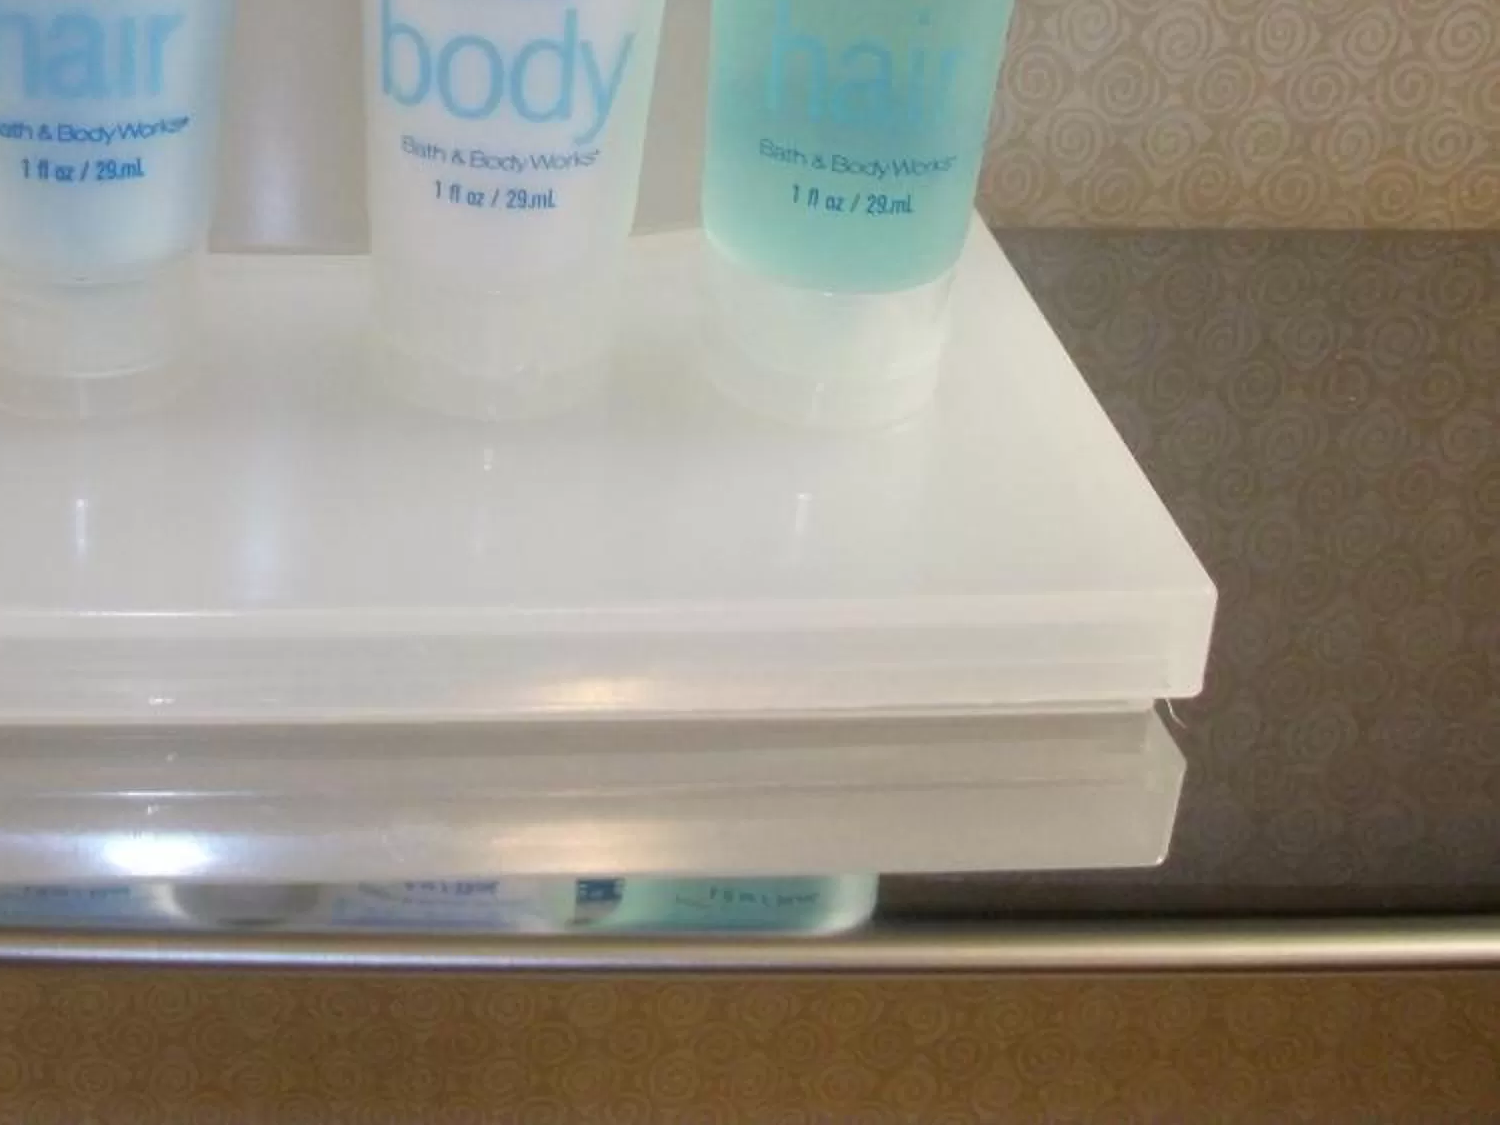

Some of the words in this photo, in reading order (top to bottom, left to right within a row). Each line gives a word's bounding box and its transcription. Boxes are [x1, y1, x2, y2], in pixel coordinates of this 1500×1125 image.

[38, 124, 53, 141] &
[58, 123, 115, 146] Body
[402, 134, 446, 162] Bath
[452, 150, 466, 164] &
[470, 149, 525, 173] Body
[759, 138, 808, 165] Bath
[812, 155, 827, 169] &
[832, 155, 888, 179] Body
[22, 159, 30, 179] 1
[37, 159, 49, 180] fl
[55, 164, 75, 181] oz
[79, 159, 89, 181] /
[435, 179, 442, 199] 1
[450, 183, 461, 203] fl
[467, 191, 484, 207] oz
[491, 188, 499, 208] /
[793, 184, 800, 203] 1
[808, 188, 819, 209] fl
[825, 196, 844, 212] oz
[851, 193, 860, 212] /
